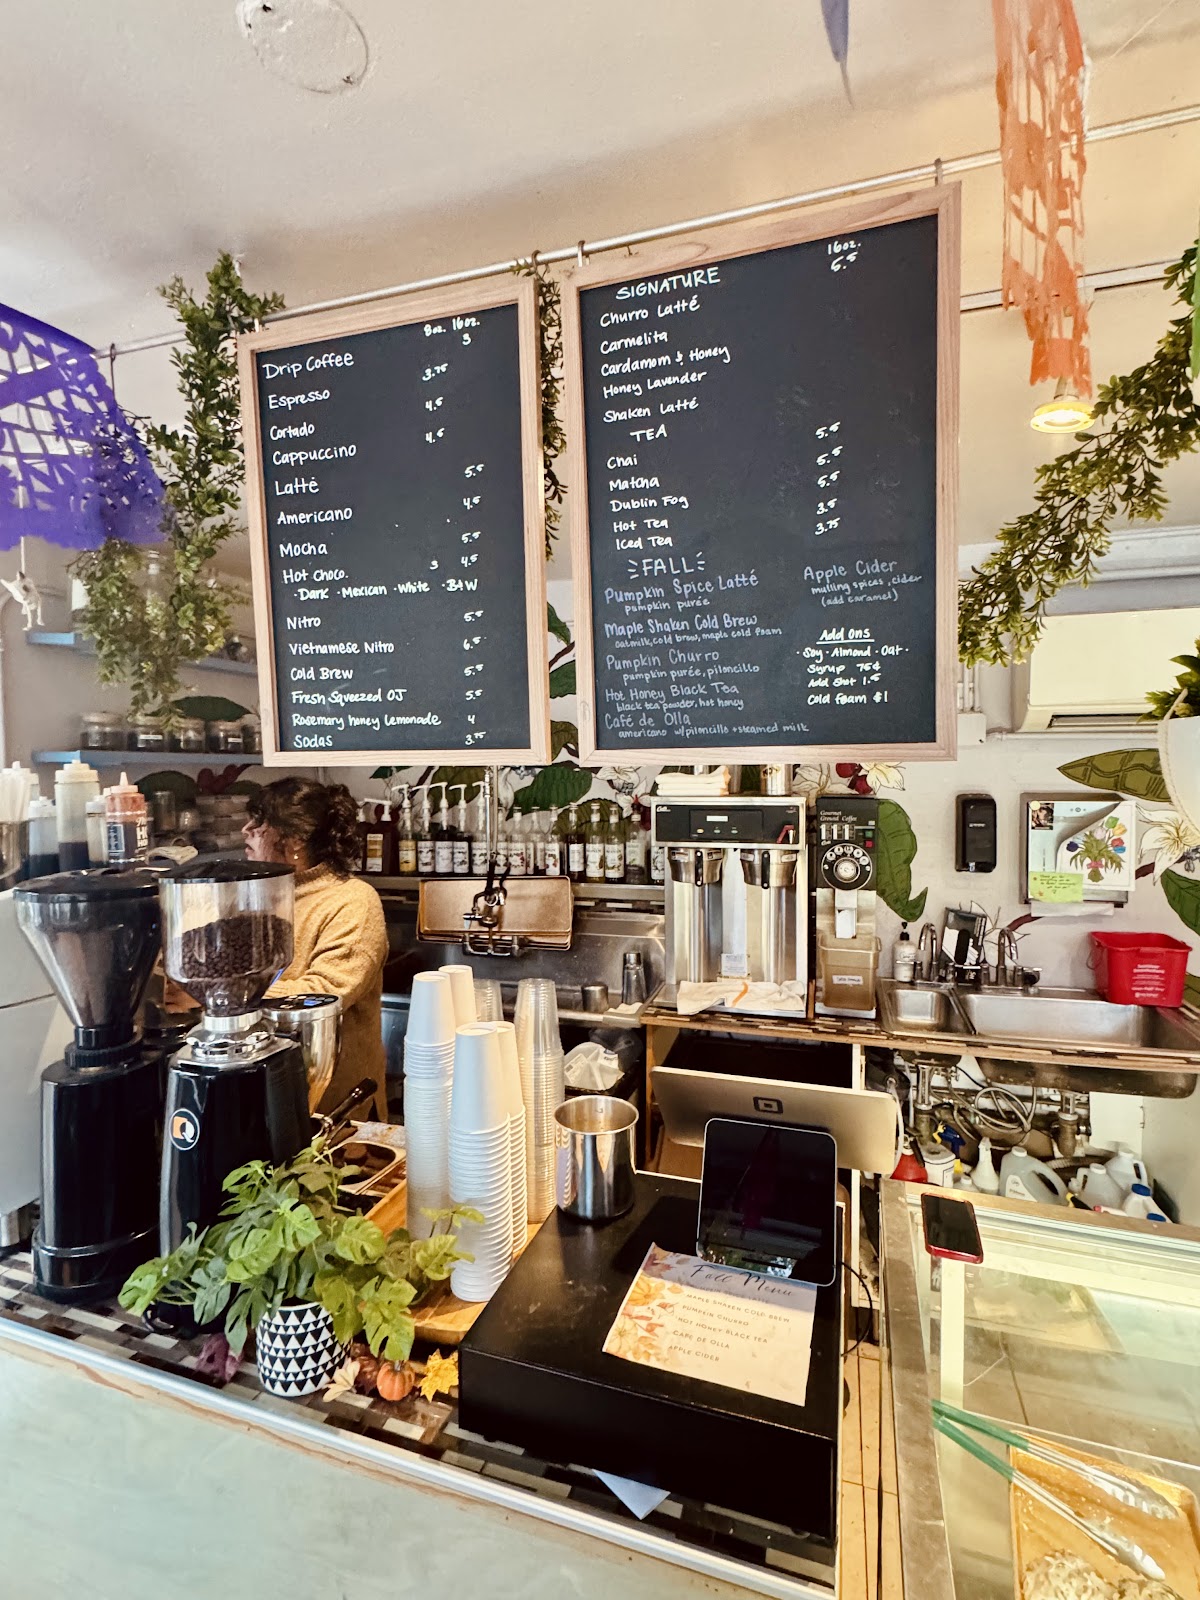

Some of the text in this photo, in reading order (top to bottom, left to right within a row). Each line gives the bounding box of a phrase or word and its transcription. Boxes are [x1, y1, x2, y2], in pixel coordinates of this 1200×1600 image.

[827, 240, 861, 255] 16oz.
[616, 267, 720, 300] SIGNATURE
[452, 316, 480, 331] 16oz.
[600, 309, 649, 328] Churro
[462, 333, 472, 345] 3
[600, 330, 669, 354] Carmelita
[263, 353, 354, 379] Drip Coffee
[601, 357, 671, 376] Cardamom
[689, 346, 731, 363] Honey
[603, 371, 707, 398] Honey Lavender
[268, 389, 330, 410] Espresso
[603, 407, 651, 422] Shaken
[270, 422, 315, 440] Cortado
[630, 425, 667, 442] TEA
[273, 445, 357, 466] Cappuccino
[607, 454, 638, 469] Chai
[609, 476, 660, 491] Matcha
[610, 495, 689, 512] Dublin Fog
[277, 508, 352, 525] Americano
[613, 519, 669, 533] Hot Tea
[279, 543, 328, 557] Mocha
[616, 536, 673, 550] Iced Tea
[430, 561, 438, 570] 3
[642, 556, 695, 576] FALL
[803, 558, 898, 583] Apple Cider
[283, 569, 308, 584] Hot
[604, 586, 665, 604] Pumpkin
[673, 578, 714, 598] Spice
[811, 582, 851, 595] mulling
[624, 600, 671, 615] pumpkin
[286, 616, 321, 629] Nitro
[647, 617, 690, 633] Shaken
[694, 614, 719, 631] Cold
[723, 613, 758, 629] Brew
[702, 631, 729, 642] maple
[731, 627, 751, 638] cold
[755, 627, 783, 636] foam
[819, 627, 844, 641] Add
[289, 641, 394, 655] Vietnamese Nitro
[606, 648, 720, 671] Pumpkin Churro
[290, 666, 353, 680] Cold Brew
[622, 669, 667, 686] pumpkin
[806, 664, 846, 675] Syrup
[807, 677, 829, 688] Add
[832, 677, 857, 687] Shot
[291, 688, 407, 706] Fresh Squeezed OJ
[605, 681, 740, 704] Hot Honey Black Tea
[807, 690, 888, 705] Cold foam $1
[615, 701, 643, 712] black
[644, 702, 661, 710] tea
[699, 698, 715, 708] hot
[717, 698, 745, 711] honey
[292, 714, 345, 730] Rosemary
[348, 715, 380, 730] honey
[467, 715, 475, 725] 4
[604, 712, 691, 729] Café de Olla
[618, 729, 667, 739] americano
[782, 722, 810, 732] milk
[293, 735, 333, 748] Sodas
[690, 1264, 792, 1297] Fall Menu
[682, 1305, 749, 1326] PUMPKIN CHURRO
[686, 1294, 710, 1304] MAPLE
[712, 1299, 742, 1312] SHAKEN
[768, 1314, 790, 1323] BREW
[677, 1317, 768, 1344] HOT HONEY BLACK TEA
[709, 1339, 730, 1349] OLLA
[668, 1345, 720, 1362] APPLE CIDER
